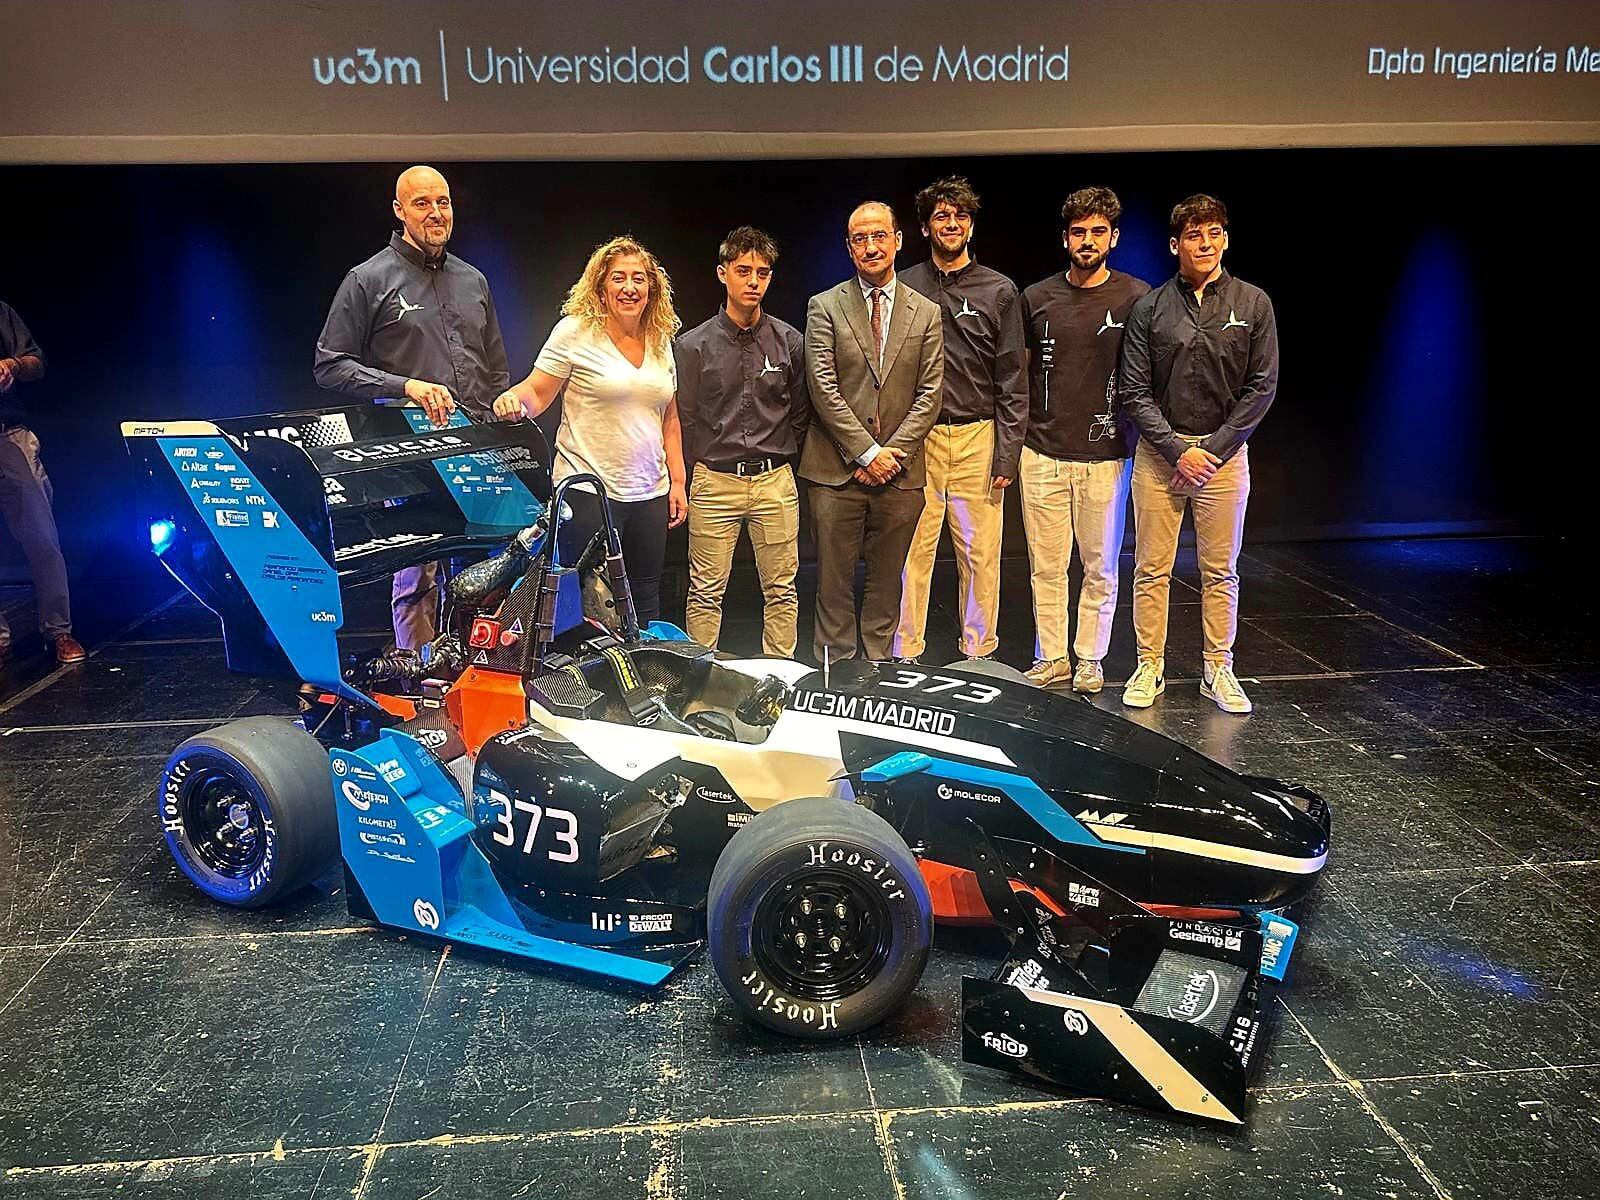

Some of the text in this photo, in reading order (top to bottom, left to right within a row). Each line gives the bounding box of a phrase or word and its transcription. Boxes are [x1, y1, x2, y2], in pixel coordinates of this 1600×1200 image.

[312, 48, 421, 86] uc3m
[466, 45, 1069, 84] Universidad Carlos III de Madrid
[1367, 47, 1425, 80] Dpto
[1433, 45, 1557, 79] Ingeniería
[311, 611, 336, 623] uc3m
[878, 669, 1002, 704] 373
[793, 690, 957, 736] UC3M MADRID
[701, 787, 734, 802] lasertek
[954, 790, 1001, 803] MOLECOR
[490, 788, 579, 863] 373
[805, 841, 905, 901] Hoosier
[1169, 921, 1243, 938] FUNDACIÓN
[1169, 928, 1226, 948] Gestamp
[742, 971, 842, 1030] Hoosier
[1181, 971, 1210, 1017] lasertek
